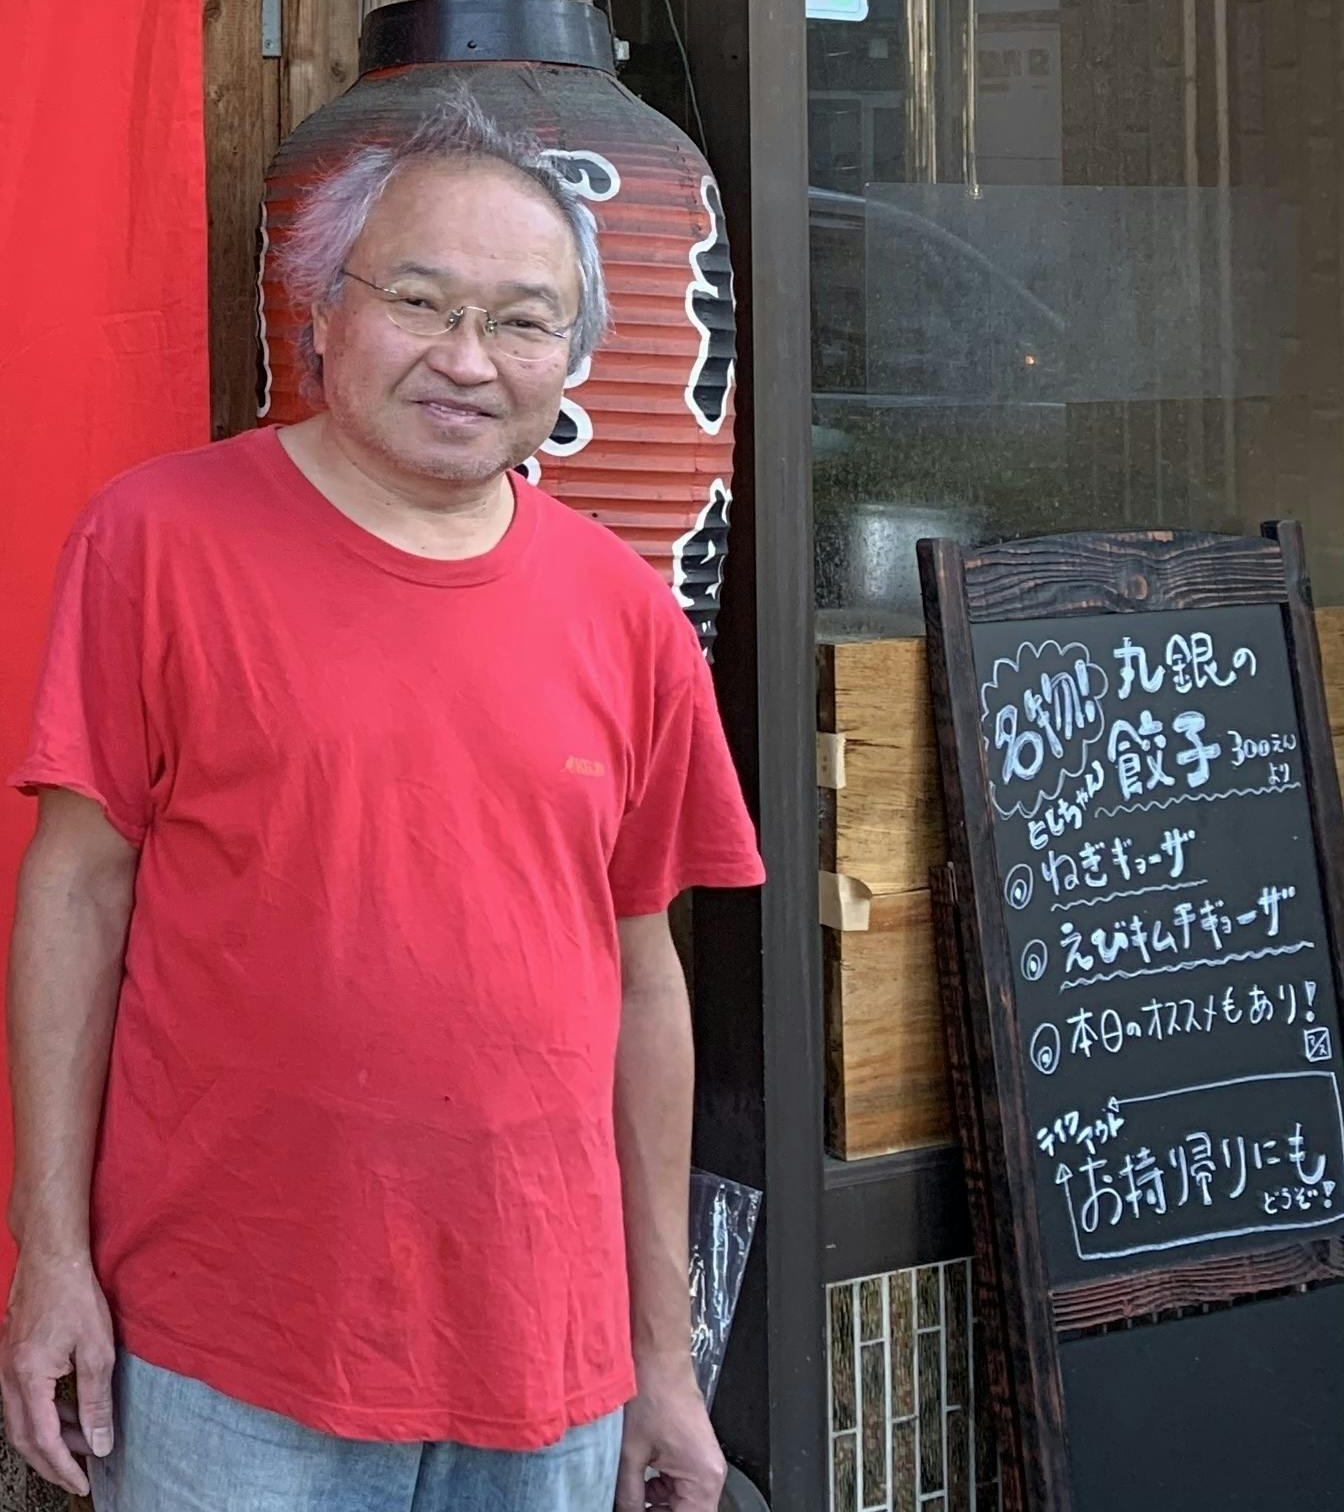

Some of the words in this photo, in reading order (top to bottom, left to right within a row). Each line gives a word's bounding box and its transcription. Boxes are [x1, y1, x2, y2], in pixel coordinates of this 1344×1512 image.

[1113, 632, 1256, 699] 丸銀の
[1107, 710, 1221, 802] 餃子
